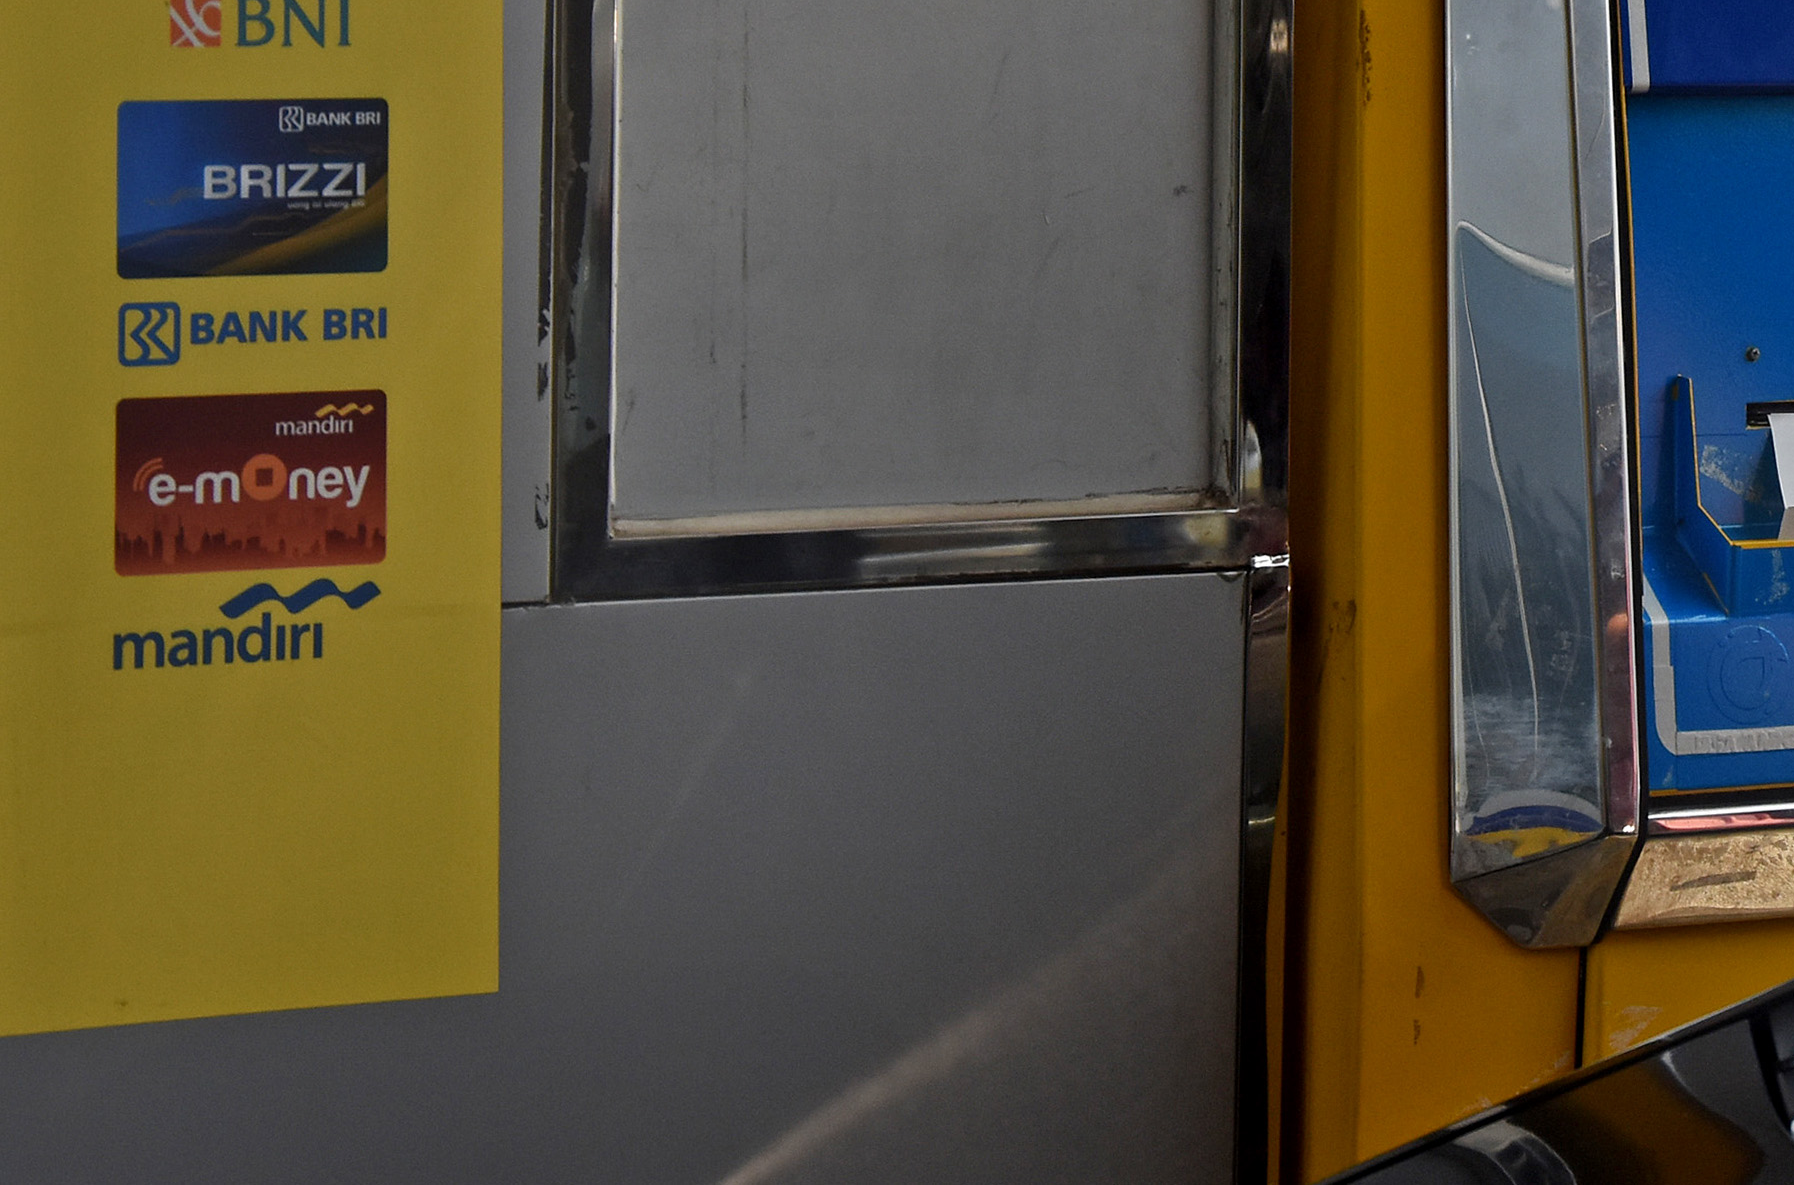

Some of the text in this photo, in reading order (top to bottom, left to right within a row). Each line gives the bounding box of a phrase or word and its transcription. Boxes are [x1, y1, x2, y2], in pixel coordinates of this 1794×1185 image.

[306, 111, 381, 126] BANK BRI
[203, 163, 366, 200] BRIZZI
[190, 307, 387, 345] BANK BRI
[275, 415, 353, 436] mandiri
[148, 453, 370, 508] e-money
[113, 612, 323, 671] mandiri
